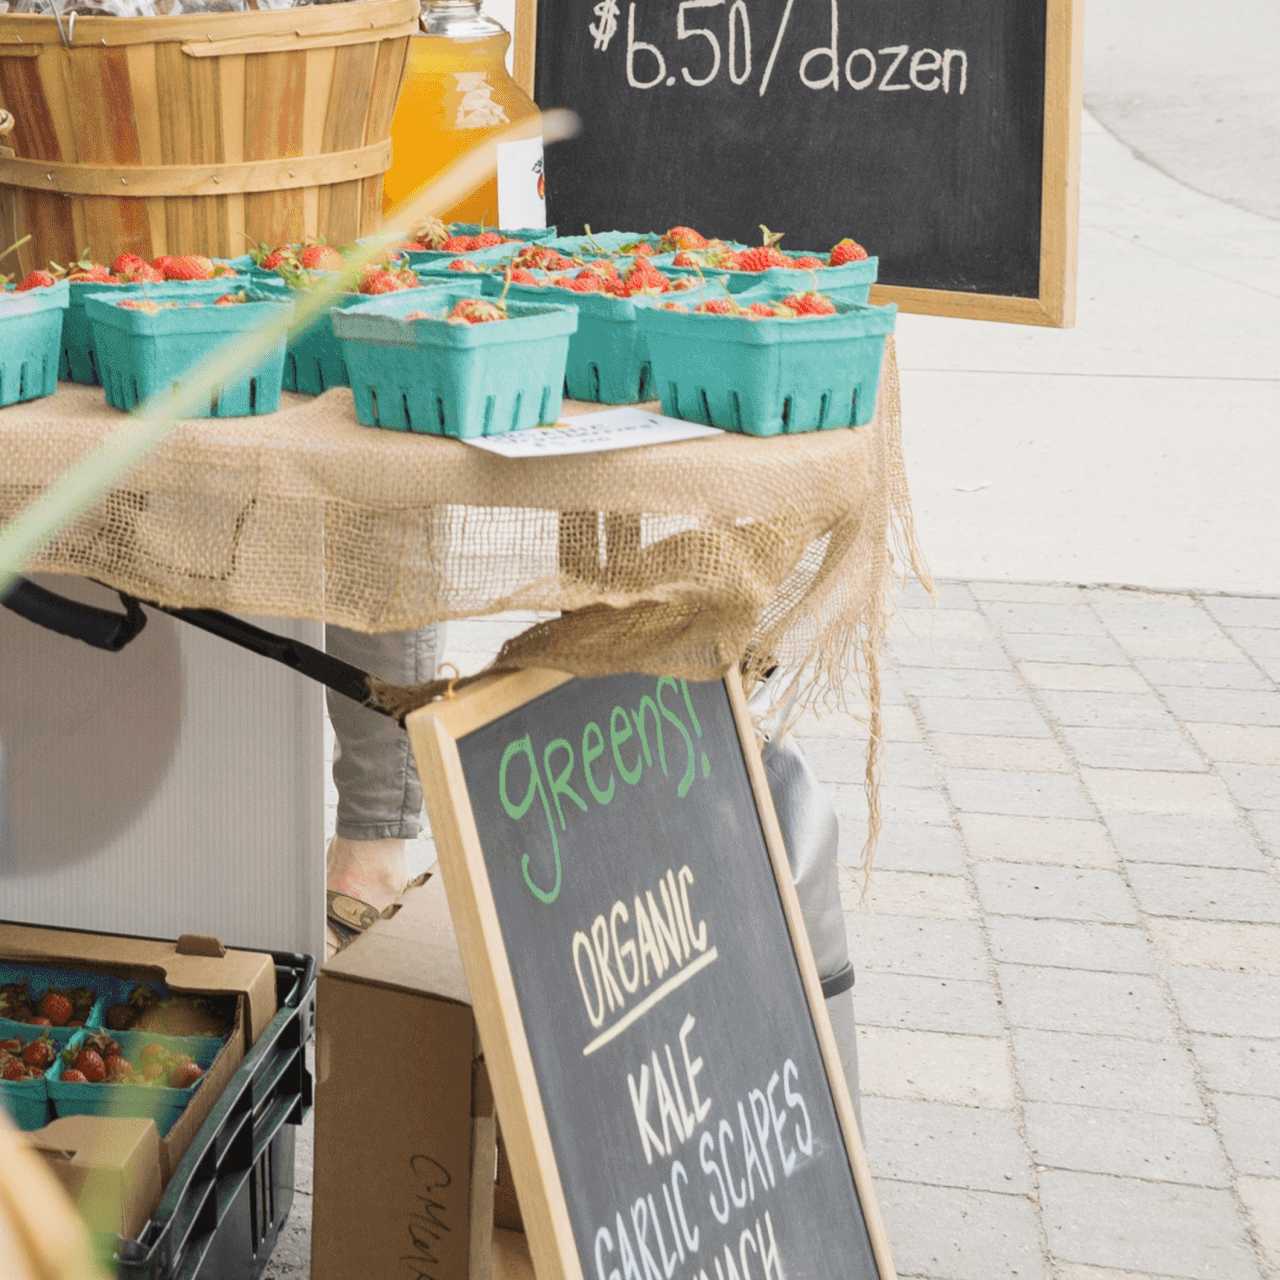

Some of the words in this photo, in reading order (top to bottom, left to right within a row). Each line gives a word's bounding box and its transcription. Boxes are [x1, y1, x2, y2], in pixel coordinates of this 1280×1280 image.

[572, 865, 708, 1028] ORGANIC
[594, 1160, 700, 1280] GARLIC
[699, 1058, 814, 1224] SCAPES
[627, 1013, 712, 1165] KALE
